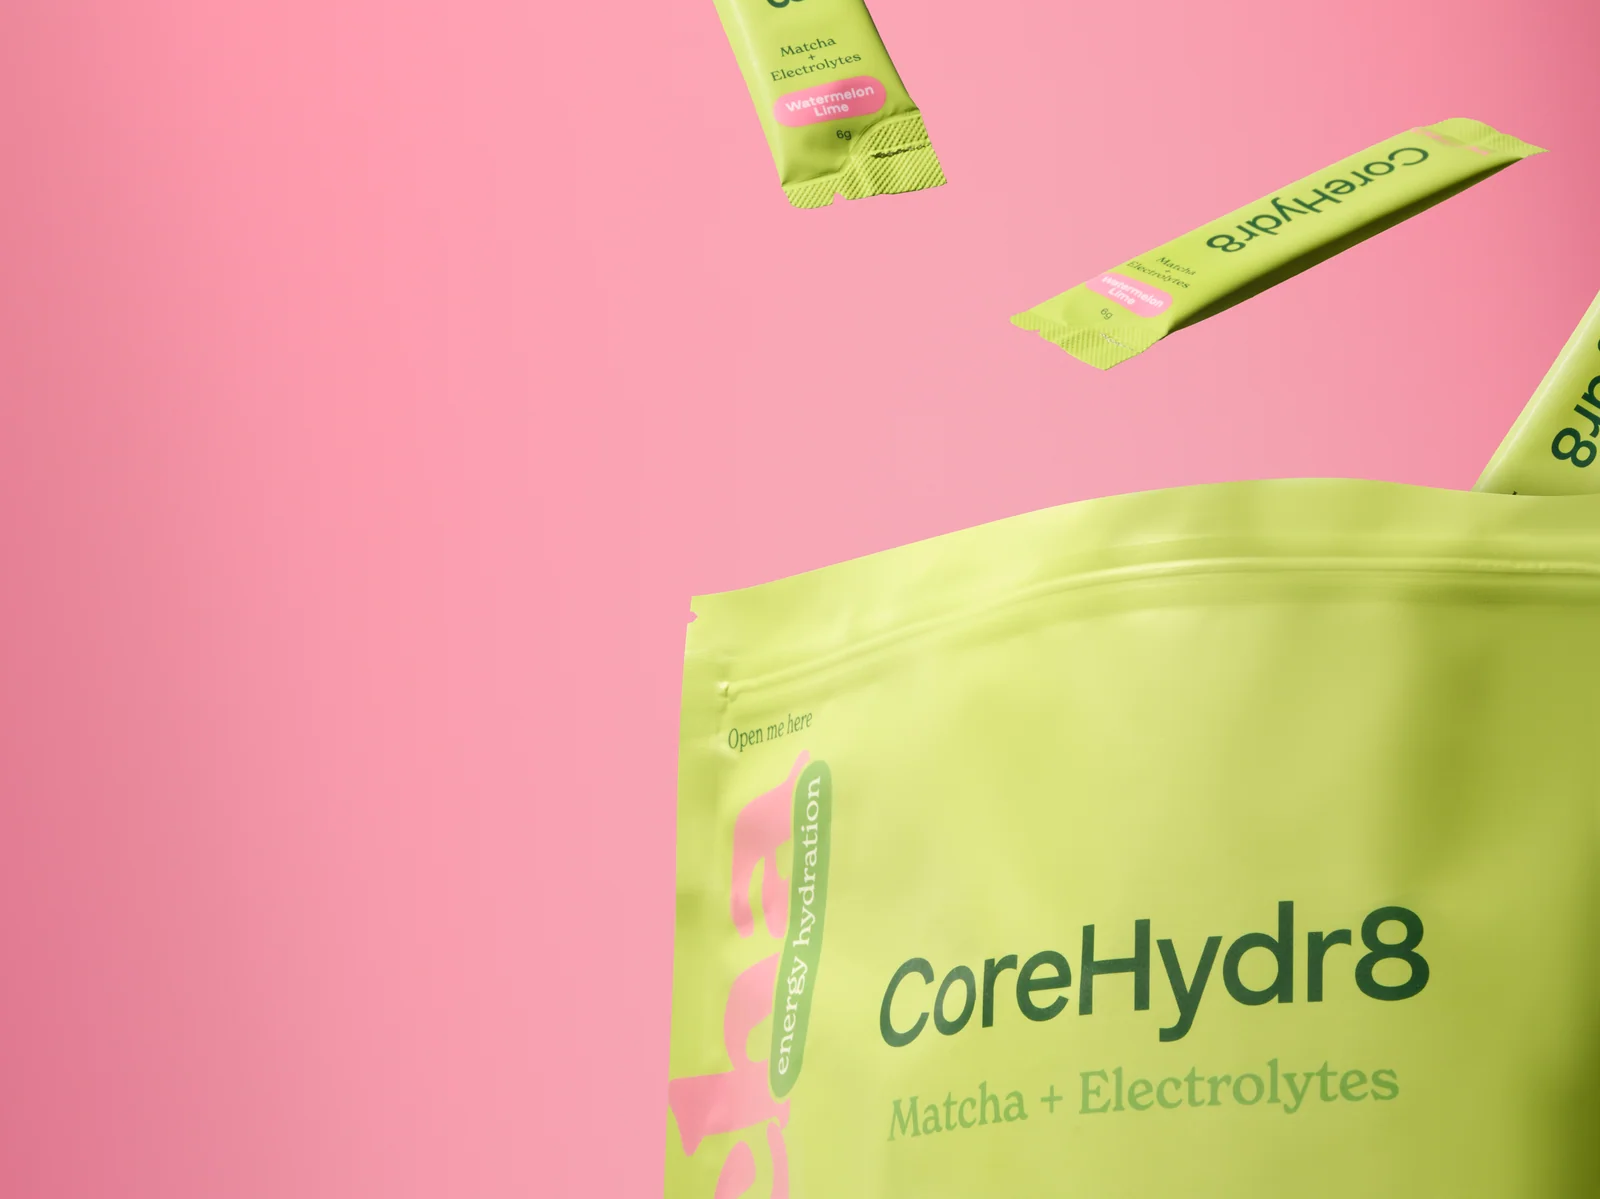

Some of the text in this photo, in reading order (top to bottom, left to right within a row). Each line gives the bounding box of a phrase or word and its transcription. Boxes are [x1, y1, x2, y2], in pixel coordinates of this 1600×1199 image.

[780, 36, 837, 58] Matcha
[770, 52, 862, 82] Electrolytes
[785, 85, 875, 112] Watermelon
[815, 102, 849, 117] Lime
[836, 130, 852, 141] 6g
[1206, 147, 1429, 253] CoreHydr8
[1126, 260, 1191, 289] Electrolytes
[1156, 257, 1196, 276] Matcha
[1102, 276, 1164, 308] Watermelon
[1108, 288, 1136, 305] Lime
[1100, 308, 1113, 320] 6g
[728, 713, 813, 752] Open me here
[777, 775, 822, 1075] energy hydration
[880, 901, 1430, 1048] CoreHydr8
[887, 1057, 1400, 1141] Matcha + Electrolytes
